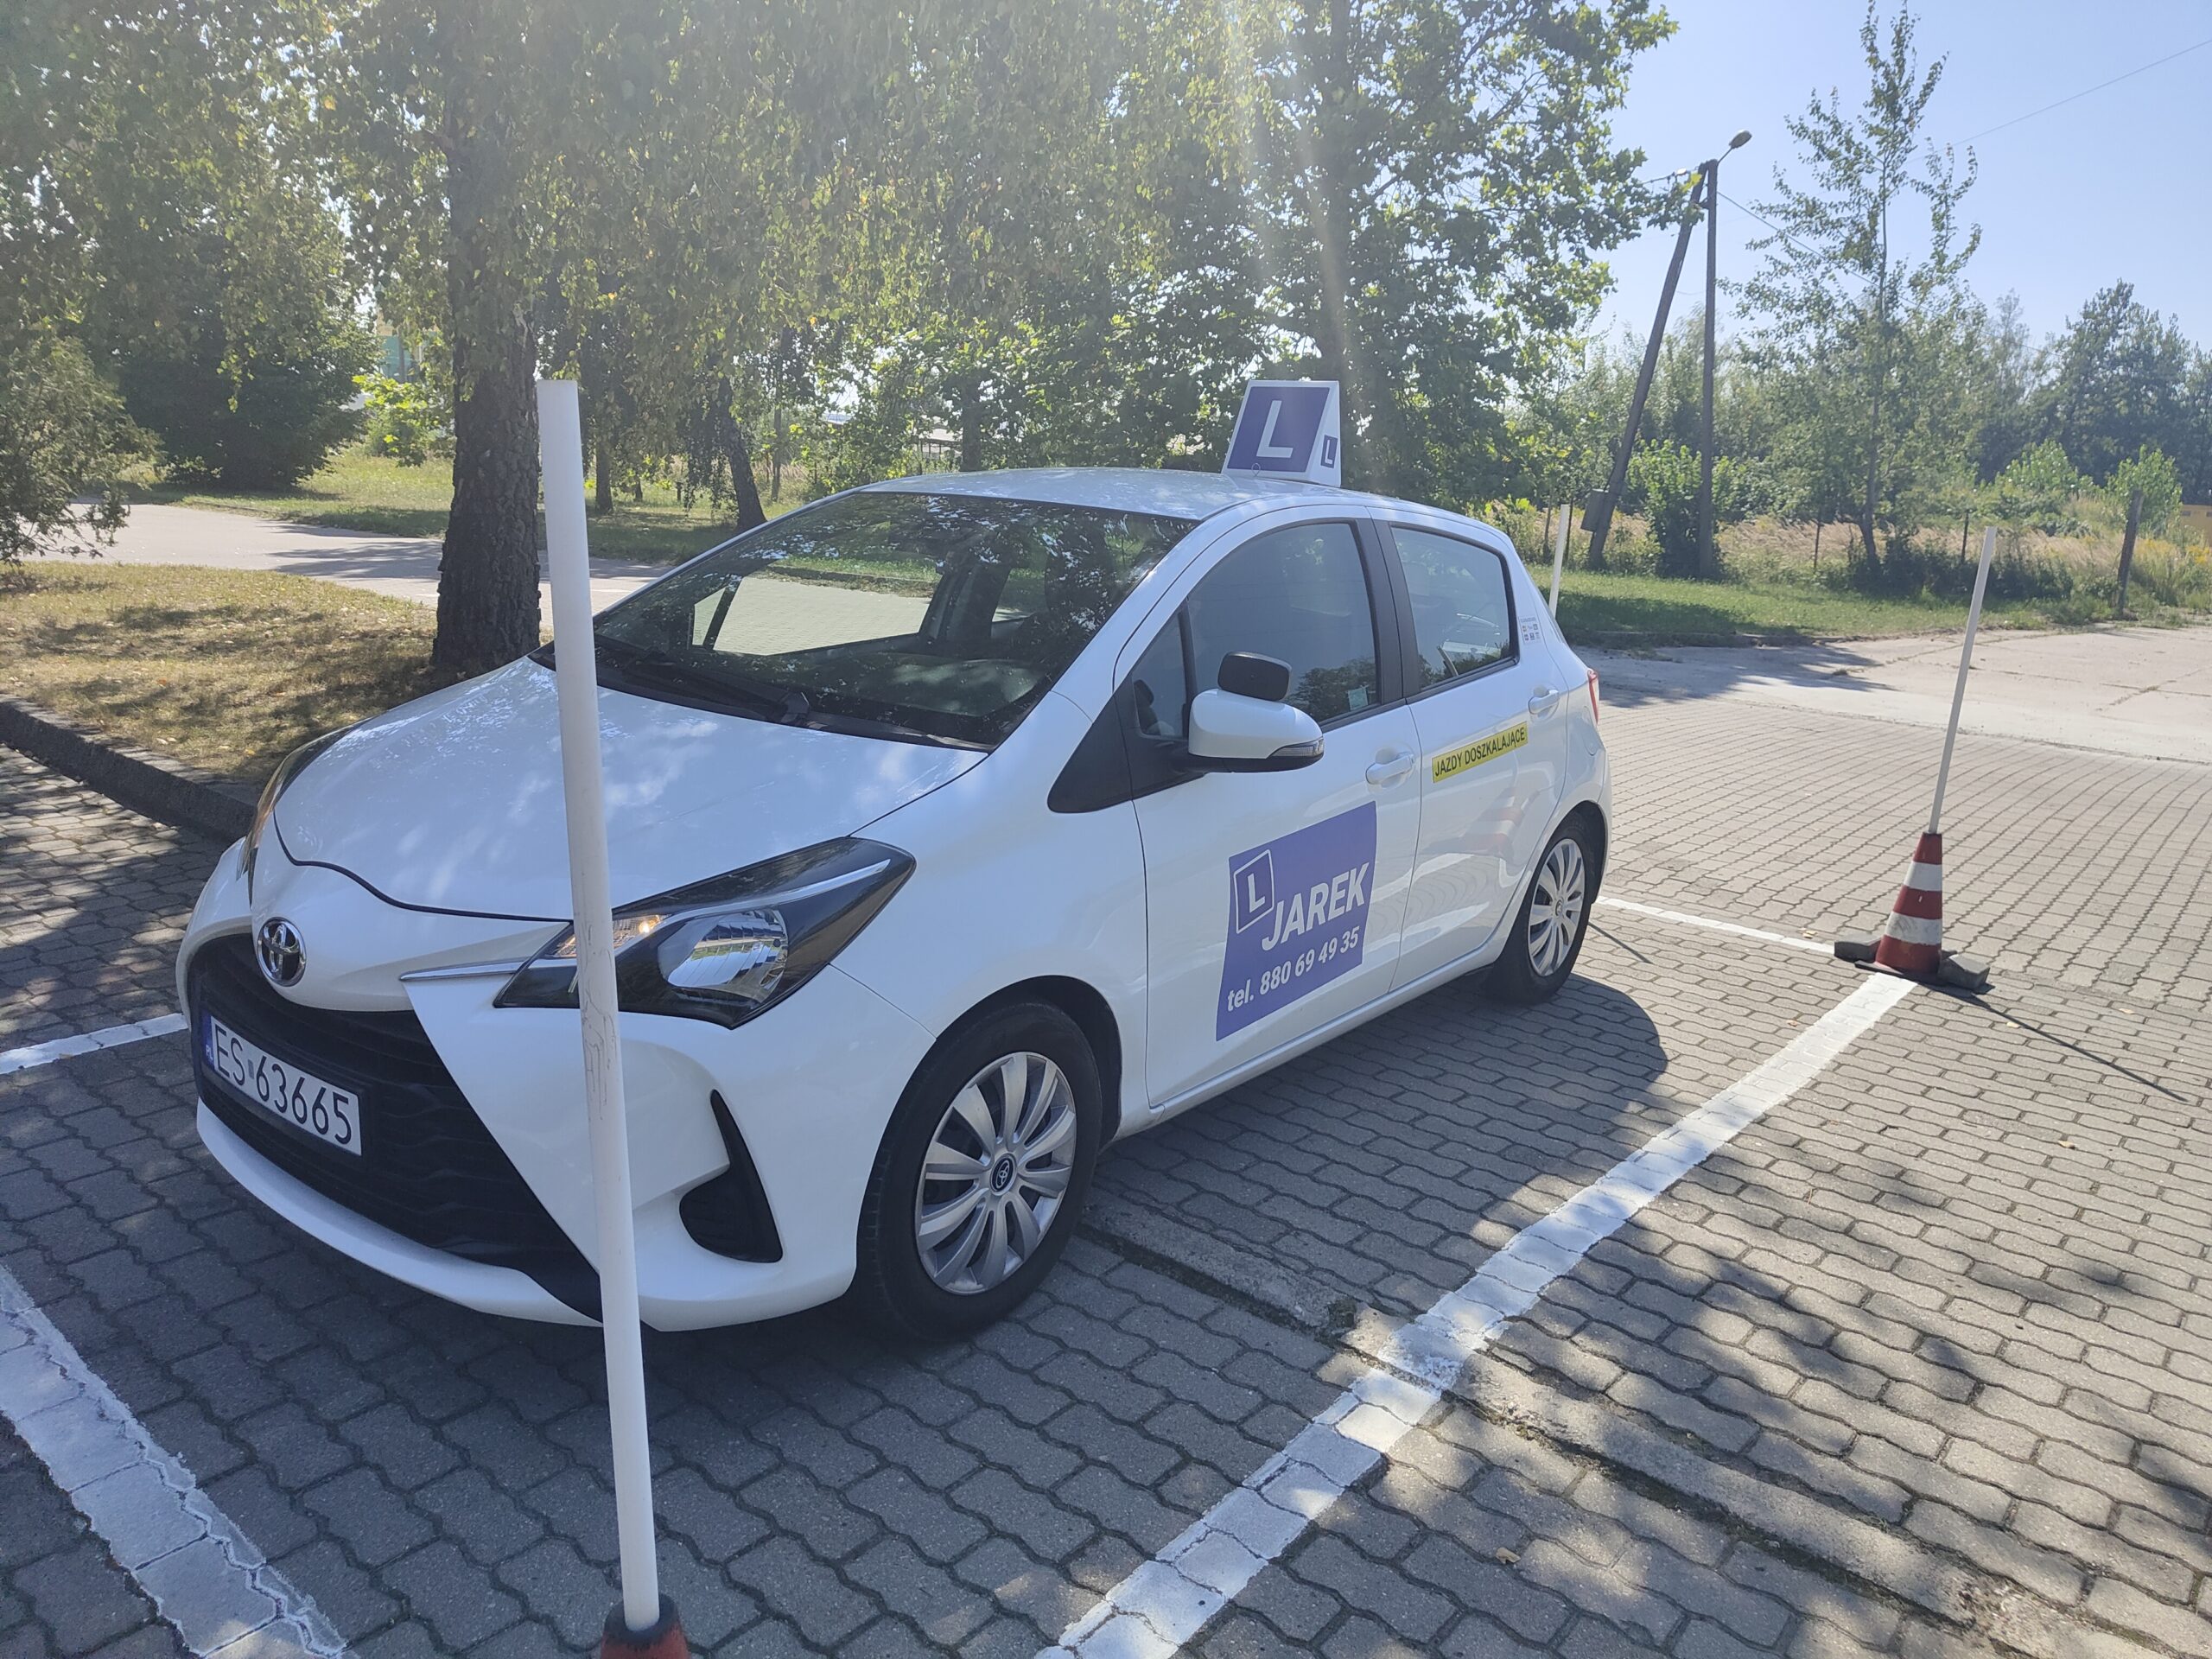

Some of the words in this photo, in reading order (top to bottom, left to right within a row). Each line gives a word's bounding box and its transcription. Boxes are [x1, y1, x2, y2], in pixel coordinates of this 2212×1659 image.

[1255, 400, 1294, 458] L
[1325, 439, 1333, 465] L
[1435, 752, 1464, 777] JAZDY
[1465, 727, 1525, 766] DOSZKALAJĄCE
[1247, 873, 1266, 913] L
[1262, 861, 1370, 951] JAREK
[1227, 979, 1254, 1012] tel.
[1259, 961, 1292, 995] 880
[1294, 949, 1315, 977] 69
[1318, 937, 1338, 964] 49
[1339, 925, 1360, 954] 35
[215, 1023, 245, 1086] ES
[256, 1055, 352, 1145] 63665
